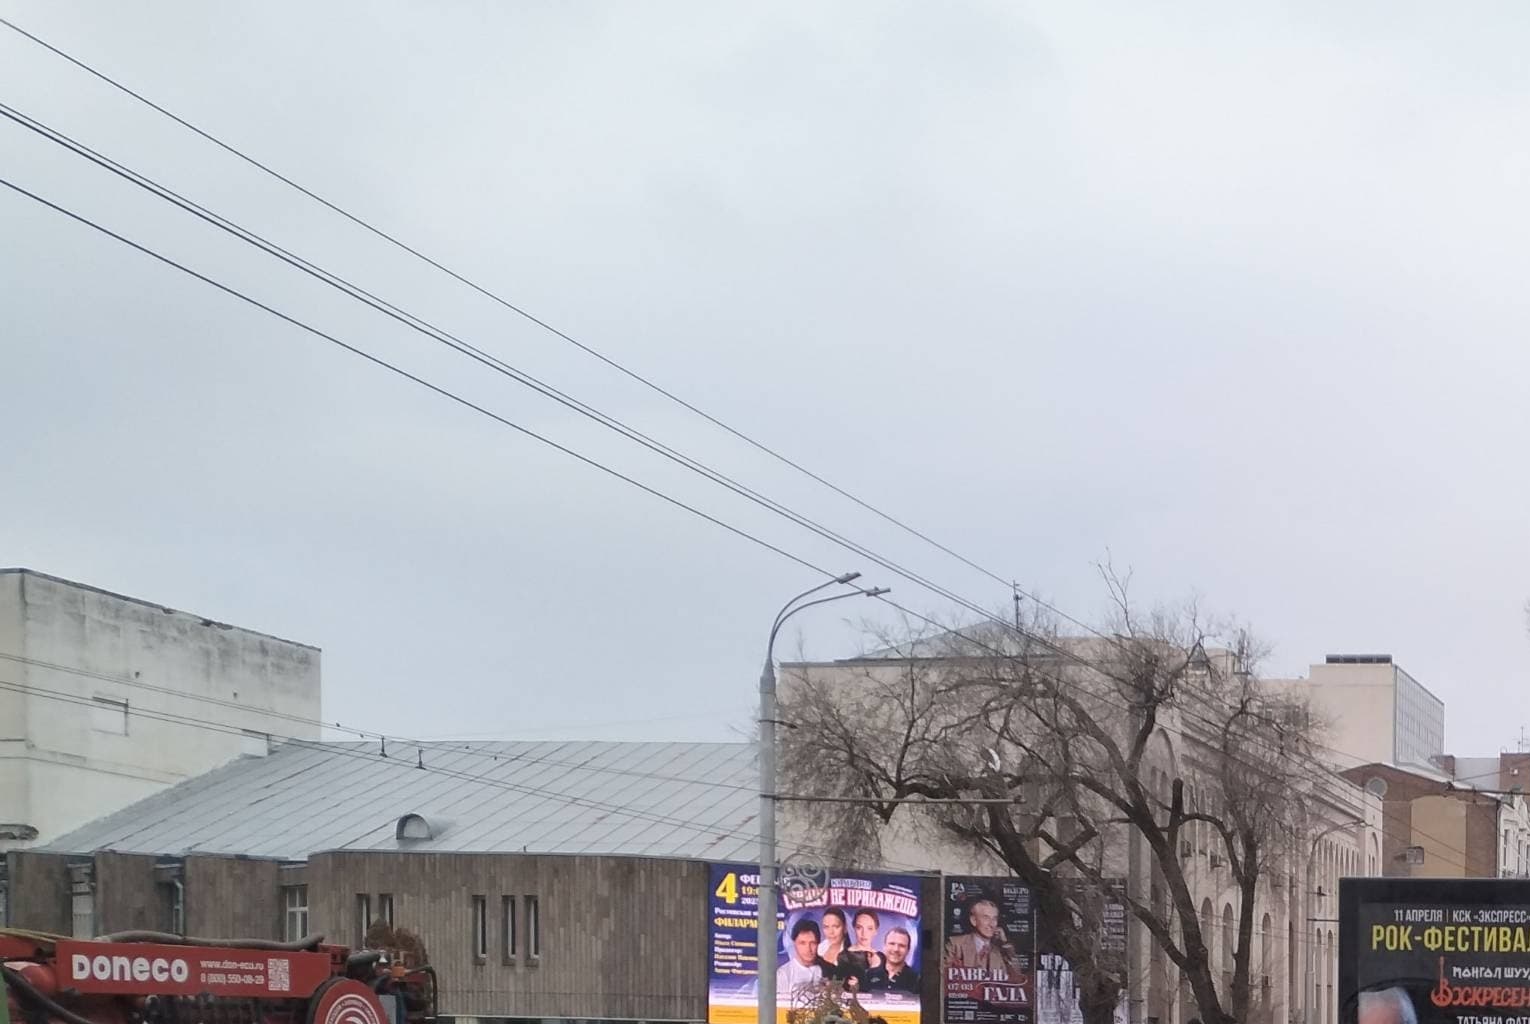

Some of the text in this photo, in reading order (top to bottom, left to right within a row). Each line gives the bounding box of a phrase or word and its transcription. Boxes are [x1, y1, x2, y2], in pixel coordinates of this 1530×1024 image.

[715, 872, 739, 904] 4
[829, 888, 846, 905] НЕ
[846, 888, 919, 917] ПРИКАЖЕШЬ
[1394, 909, 1403, 921] 11
[1405, 909, 1443, 922] АПРЕЛЯ
[1452, 910, 1472, 923] КСК
[948, 967, 1009, 981] РАВЕЛЬ
[1452, 966, 1500, 979] МОНГОЛ
[983, 986, 1028, 1001] ГАЛА
